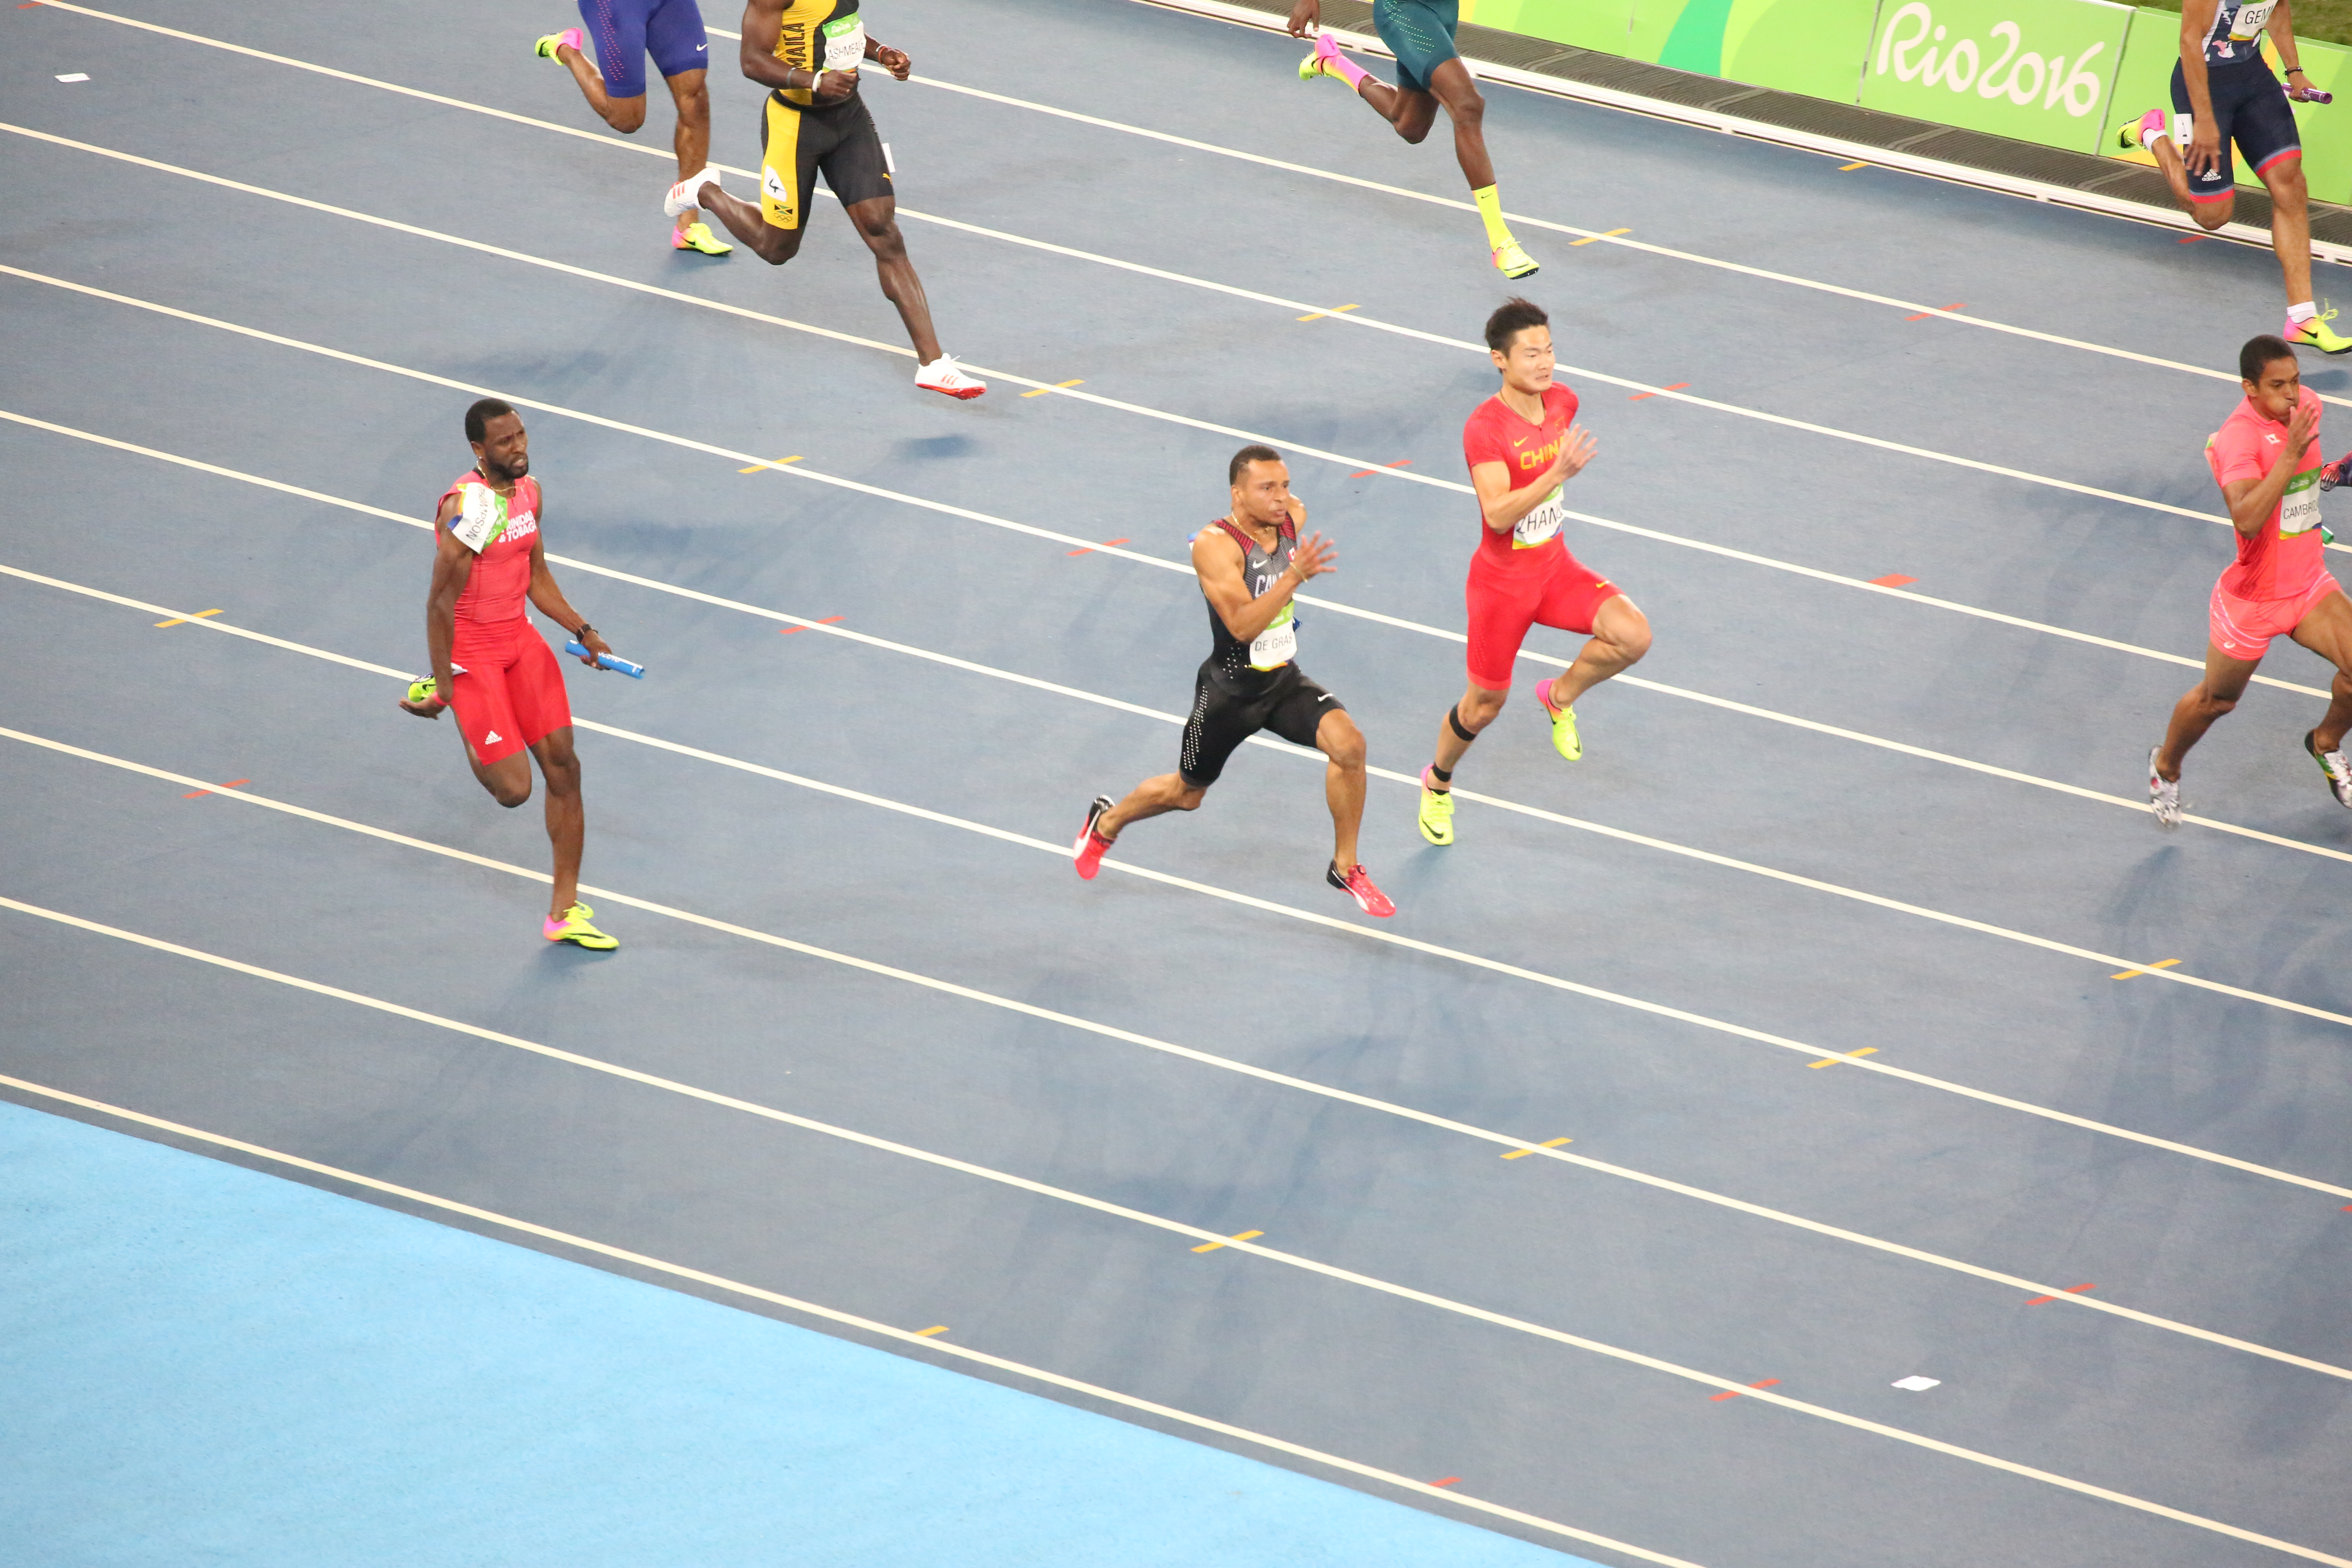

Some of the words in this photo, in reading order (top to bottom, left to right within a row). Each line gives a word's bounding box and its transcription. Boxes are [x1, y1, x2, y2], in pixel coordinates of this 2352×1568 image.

[1877, 2, 2105, 117] Rio2016
[501, 510, 534, 532] RINIDAD
[499, 534, 506, 543] &
[1255, 641, 1268, 651] DE
[485, 736, 502, 745] adidas
